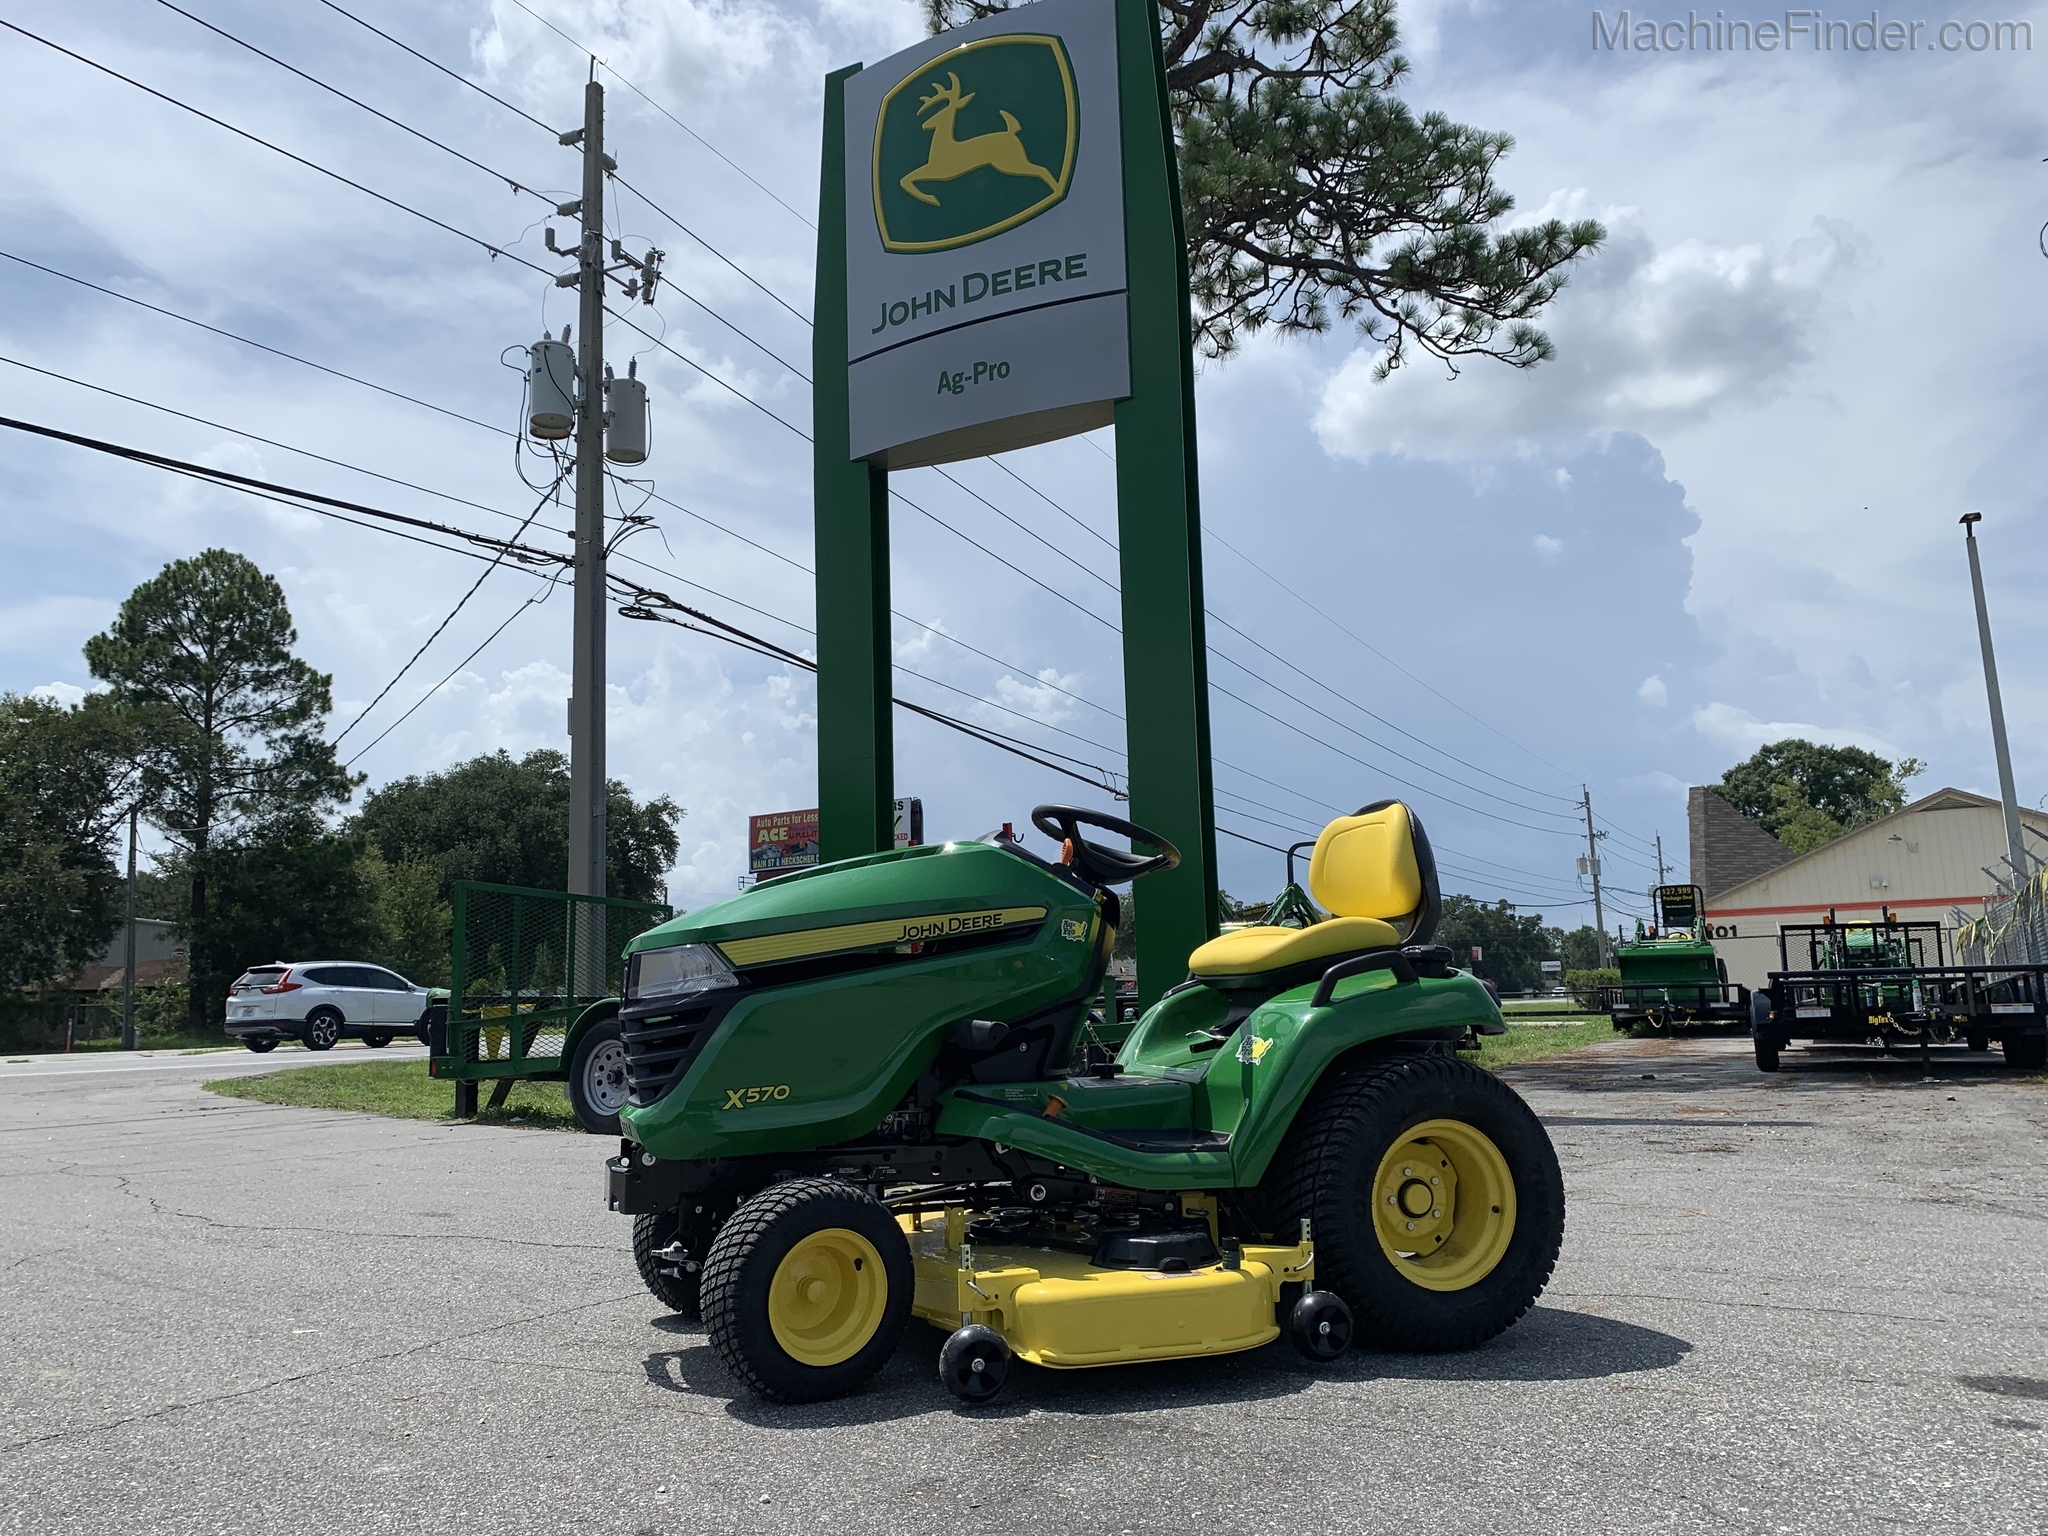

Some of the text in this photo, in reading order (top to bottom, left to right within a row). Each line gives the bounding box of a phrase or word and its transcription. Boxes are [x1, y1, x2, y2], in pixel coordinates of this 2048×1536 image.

[871, 252, 1088, 335] JOHN DEERE
[936, 360, 1011, 395] Ag-Pro
[757, 813, 818, 828] Auto Parts for Less
[757, 827, 789, 843] ACE
[753, 859, 766, 869] MAIN
[767, 858, 775, 867] ST
[781, 855, 814, 865] HECKSCHER
[897, 913, 1003, 942] JOHN DEERE
[1868, 1015, 1889, 1025] BigTex
[721, 1084, 791, 1110] X570
